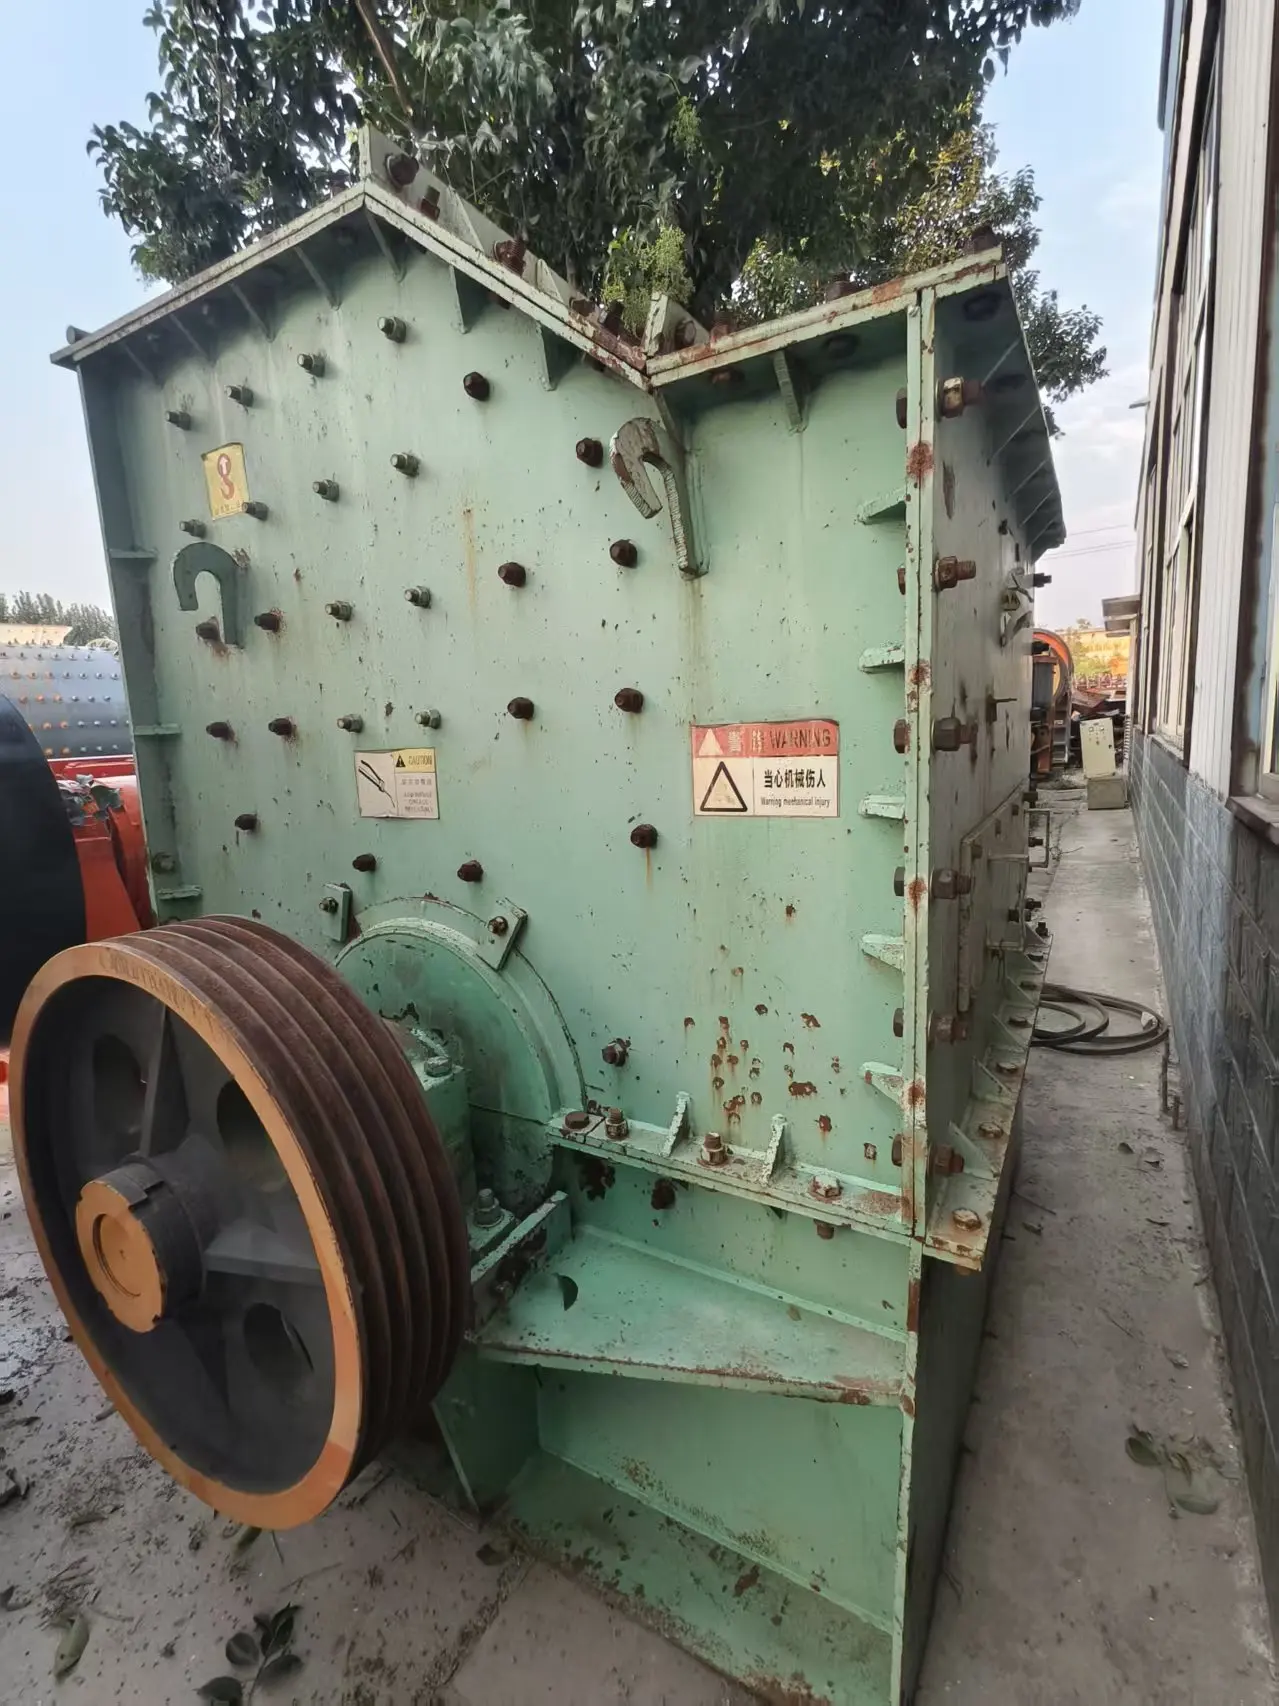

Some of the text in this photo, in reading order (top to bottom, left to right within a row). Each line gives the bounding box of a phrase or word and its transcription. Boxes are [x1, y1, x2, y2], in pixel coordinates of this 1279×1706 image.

[769, 728, 831, 748] WARNING
[408, 755, 432, 765] CAUTION
[764, 768, 826, 788] 当心机械伤人
[761, 796, 781, 807] Warning
